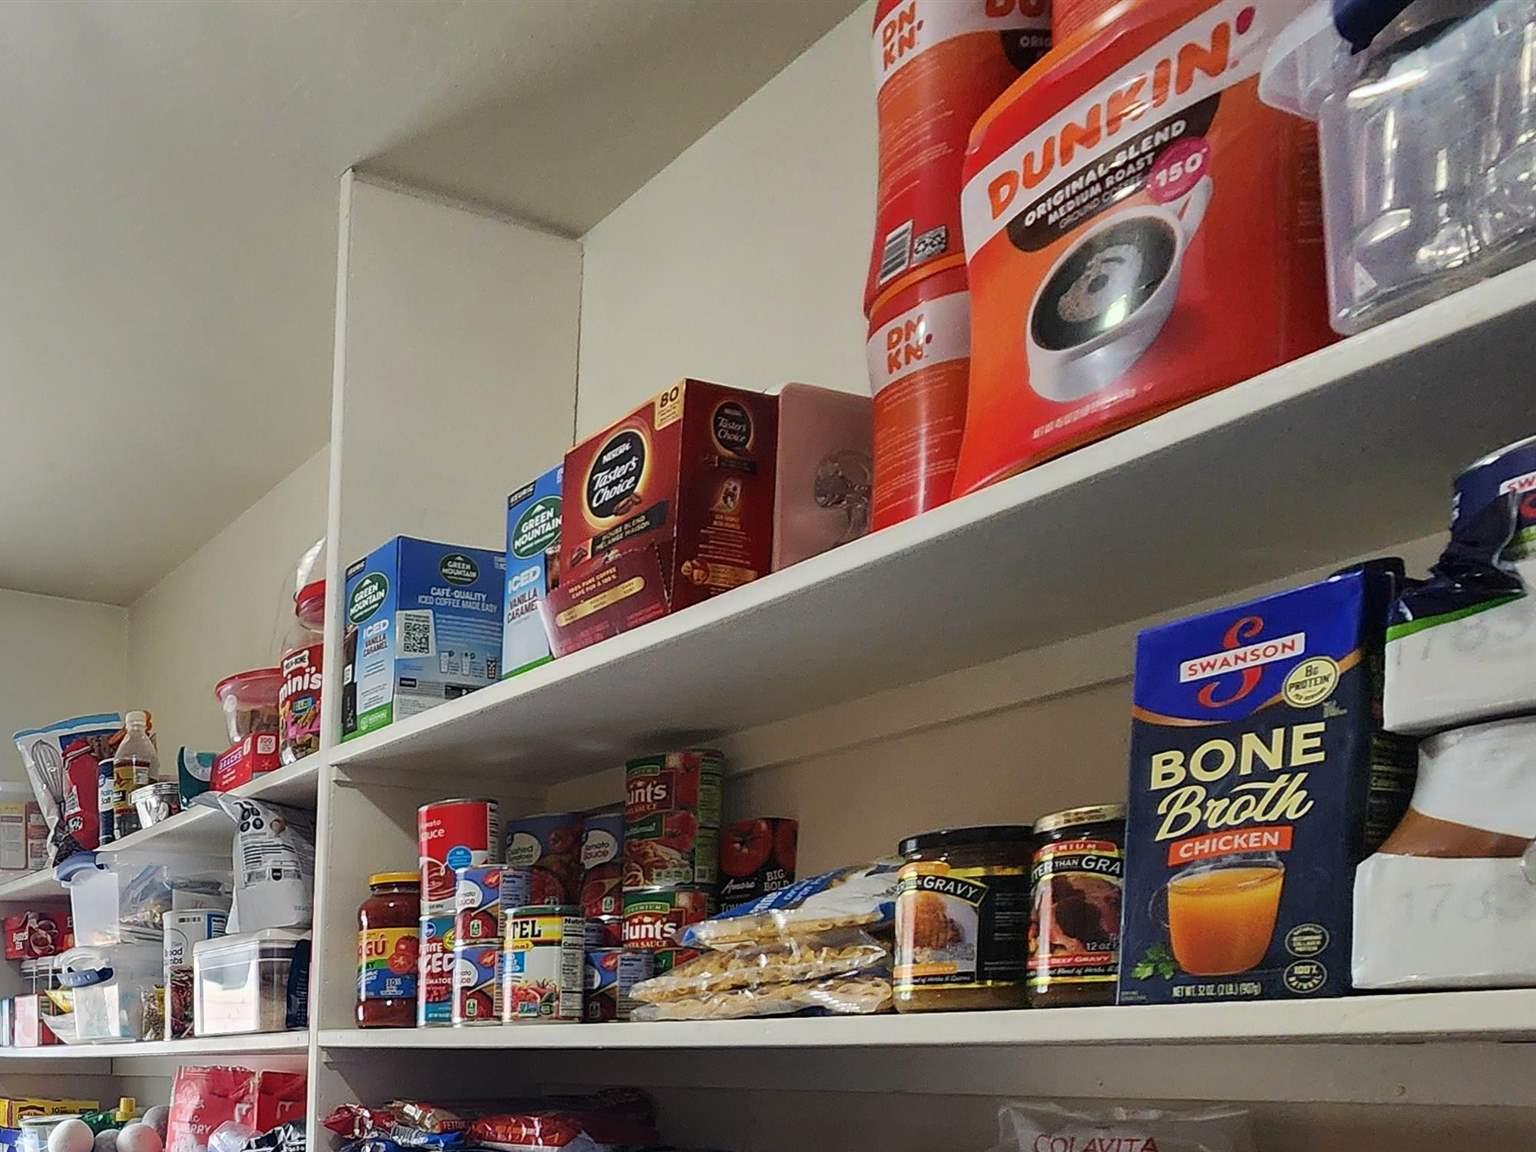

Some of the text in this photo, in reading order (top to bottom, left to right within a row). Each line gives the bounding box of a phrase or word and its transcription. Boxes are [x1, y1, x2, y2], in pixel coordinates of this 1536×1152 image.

[1024, 119, 1187, 227] ORIGINAL BLEND
[1047, 152, 1156, 226] MEDIUM ROAST
[659, 386, 680, 408] 80
[591, 454, 639, 491] Taster's
[591, 476, 636, 508] Choice
[520, 509, 555, 533] GREEN
[508, 567, 542, 593] ICED
[349, 589, 386, 614] MOUNTAIN
[354, 583, 380, 603] GREEN
[417, 594, 435, 605] ICED
[435, 597, 461, 608] COFFEE
[509, 590, 539, 609] VANILLA
[364, 619, 390, 639] ICED
[1187, 639, 1296, 678] SWANSON
[1150, 721, 1326, 791] BONE
[1154, 772, 1314, 843] Broth
[1179, 830, 1281, 859] CHICKEN
[766, 870, 785, 883] BIG
[1054, 855, 1123, 874] THAN GRA
[923, 875, 980, 899] GRAVY
[622, 917, 678, 941] Hunt's
